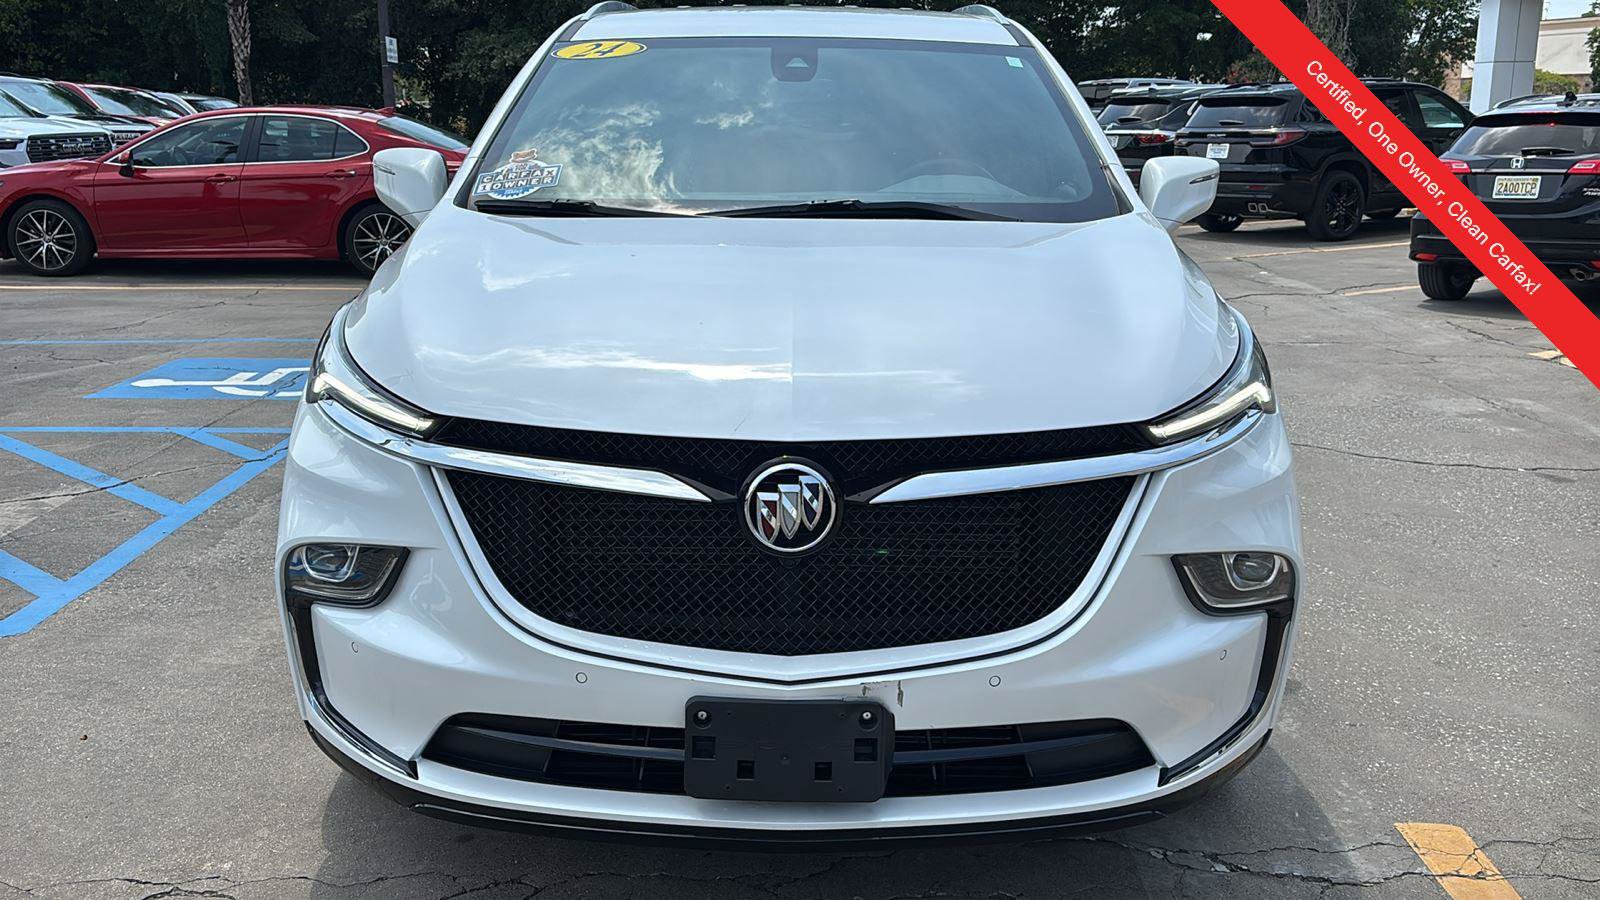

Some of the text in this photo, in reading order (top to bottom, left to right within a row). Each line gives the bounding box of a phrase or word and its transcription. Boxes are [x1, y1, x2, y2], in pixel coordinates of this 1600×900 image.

[568, 42, 626, 58] 24
[482, 168, 555, 183] CARFAX
[492, 176, 553, 191] OWNER
